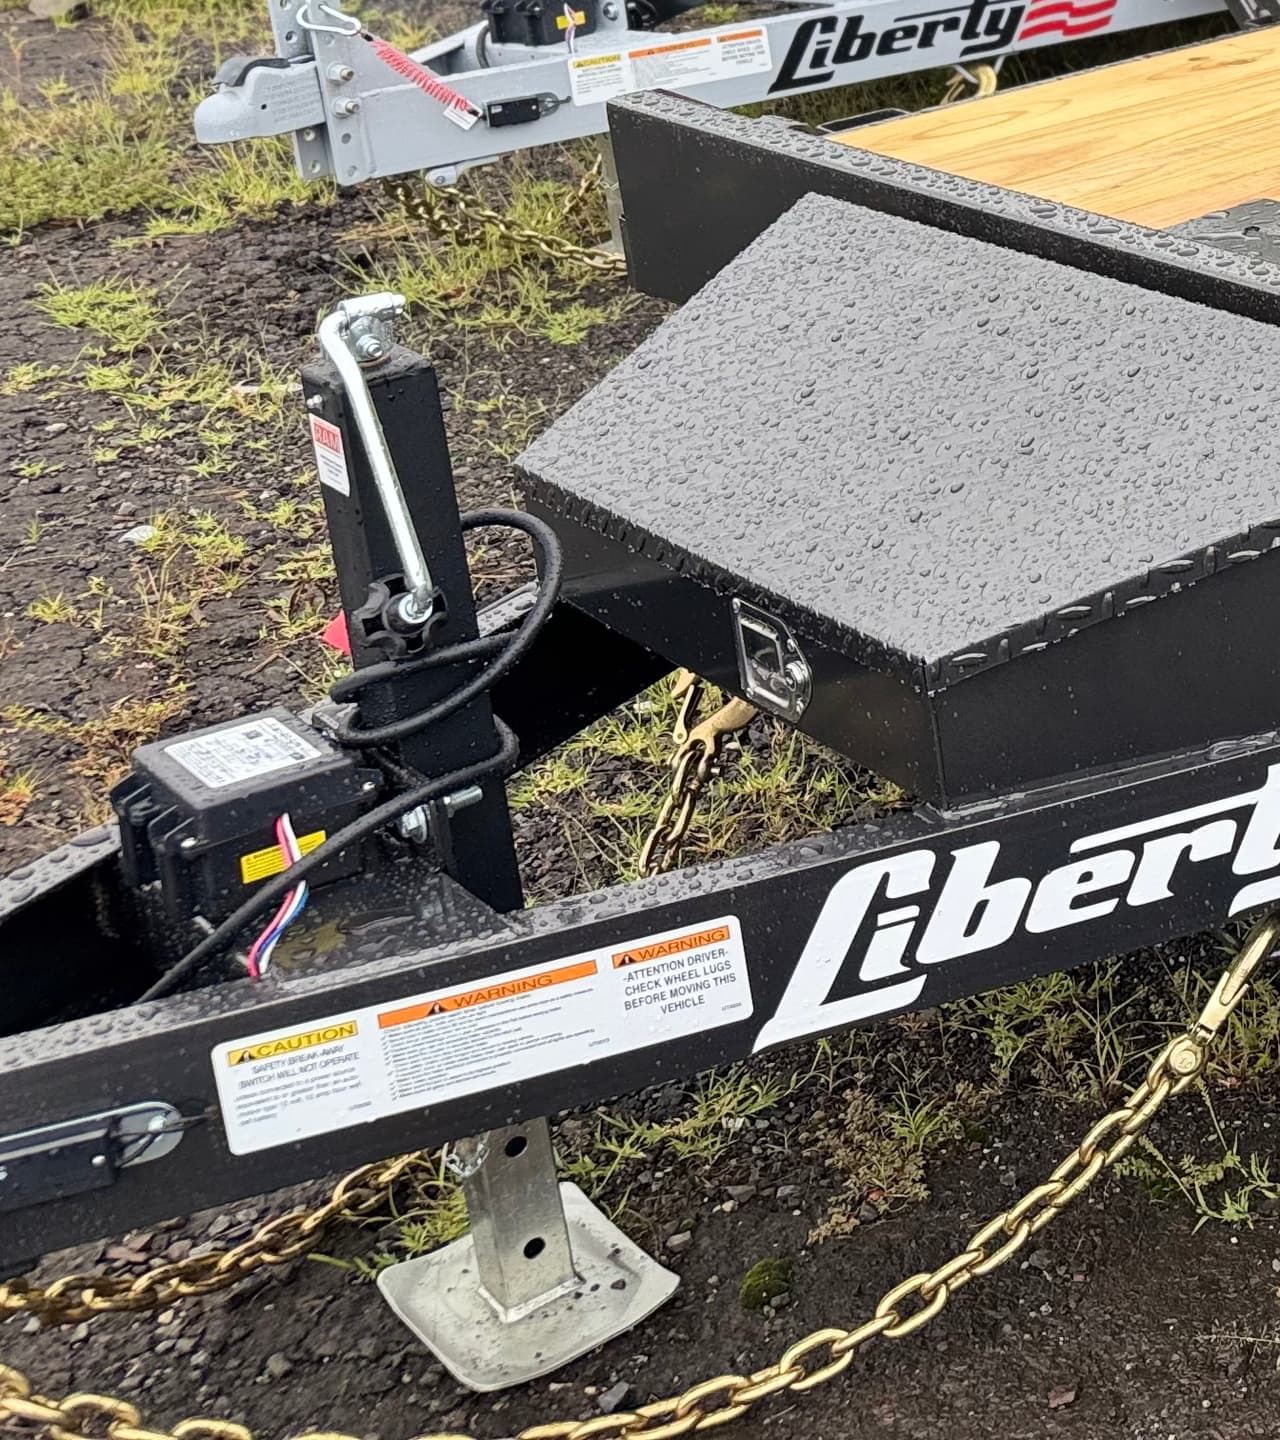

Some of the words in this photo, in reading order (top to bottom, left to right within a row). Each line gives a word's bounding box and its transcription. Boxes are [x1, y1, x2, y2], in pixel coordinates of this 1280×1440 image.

[639, 930, 725, 960] WARNING
[453, 974, 553, 1008] WARNING
[624, 991, 667, 1011] BEFORE
[670, 979, 711, 998] MOVING
[713, 972, 736, 987] THIS
[625, 978, 662, 996] CHECK
[664, 969, 701, 986] WHEEL
[704, 960, 732, 975] LUGS
[661, 994, 705, 1015] VEHICLE
[256, 1024, 354, 1056] CAUTION
[239, 1072, 277, 1089] SWITCH
[299, 1062, 318, 1076] NOT
[319, 1051, 360, 1070] OPERATE
[252, 1059, 287, 1074] SAFETY
